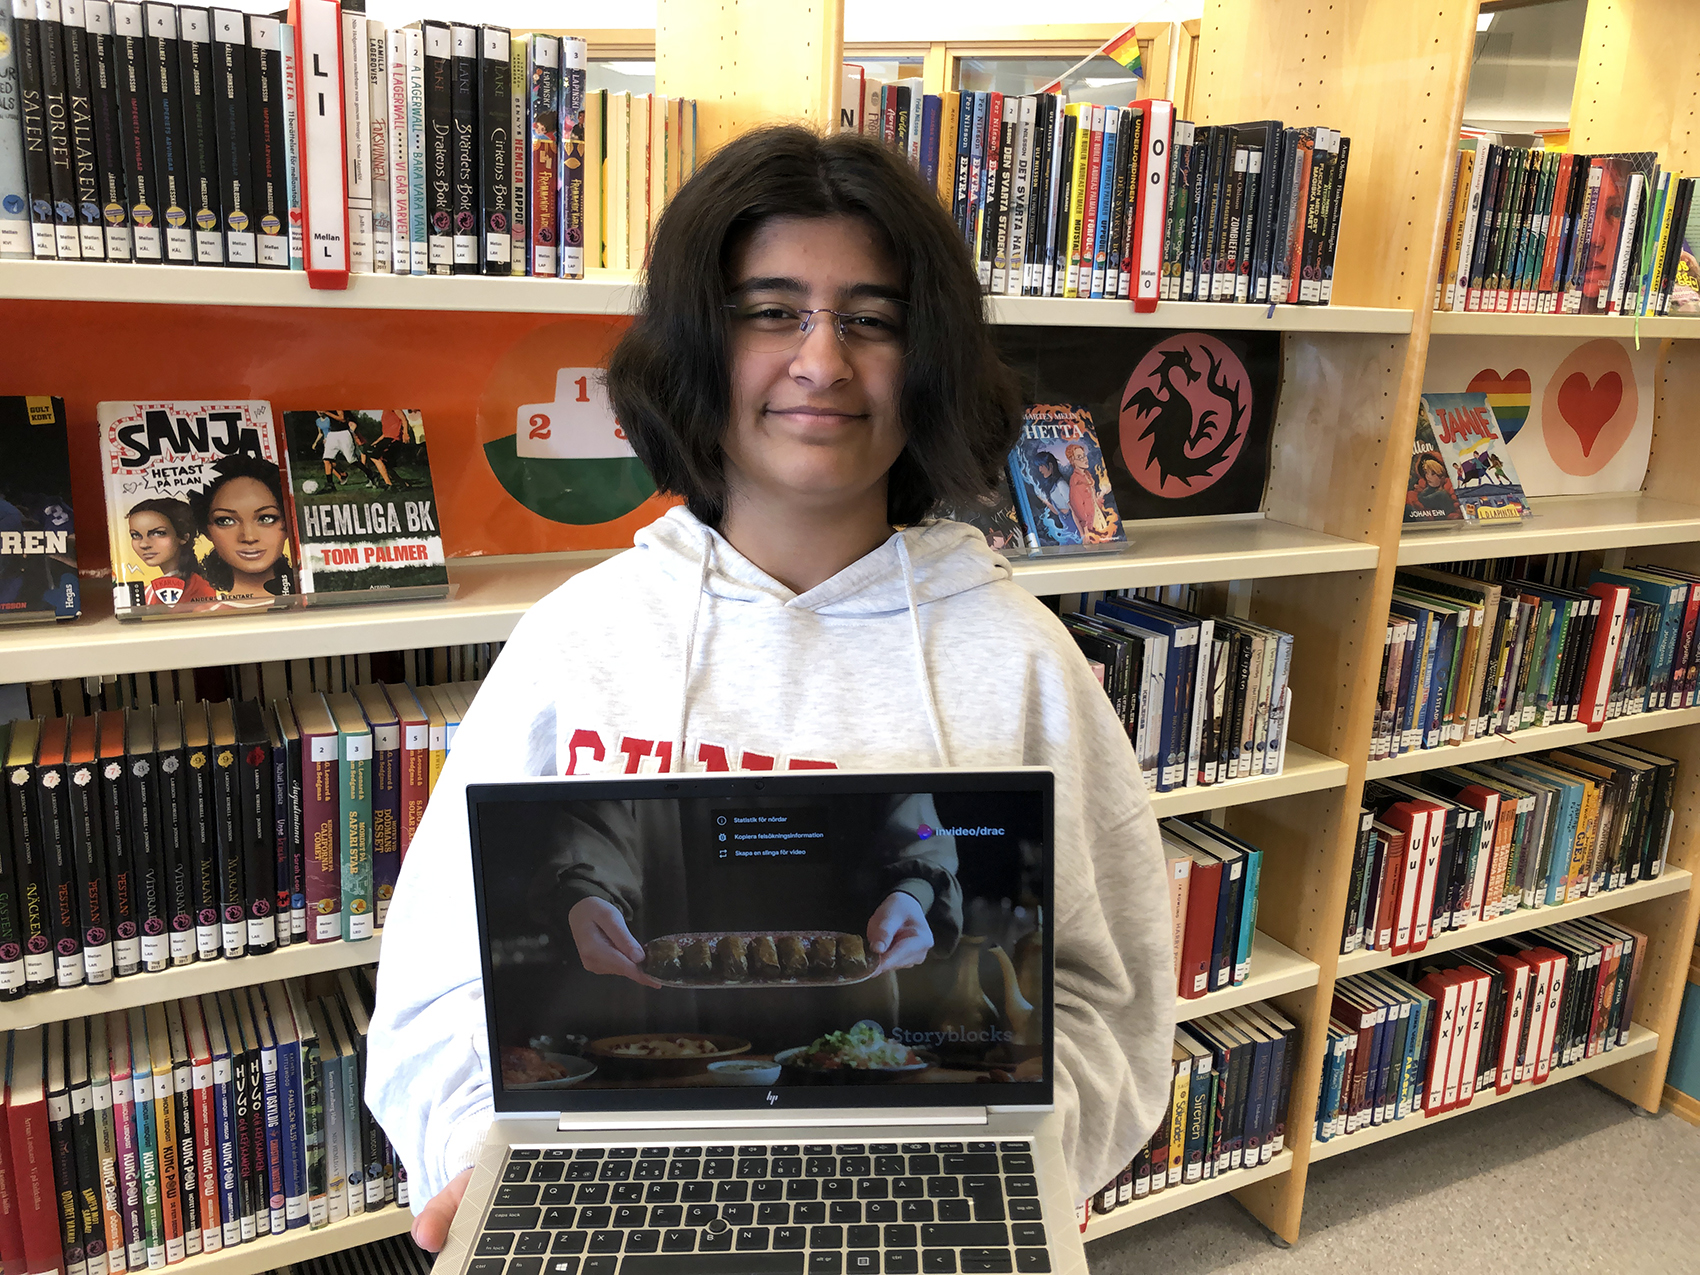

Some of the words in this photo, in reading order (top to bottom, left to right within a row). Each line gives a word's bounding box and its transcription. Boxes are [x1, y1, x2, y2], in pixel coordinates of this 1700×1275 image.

[286, 56, 294, 100] KÄRLEK
[313, 54, 328, 77] L
[393, 73, 404, 129] LAGERWALL
[411, 77, 423, 132] LAGERWALL
[572, 75, 580, 109] LAPINSKI
[23, 90, 43, 152] SALEN
[841, 109, 854, 127] N
[47, 93, 69, 169] TORPET
[288, 118, 296, 154] berättelser
[962, 115, 970, 148] Nilsson
[975, 116, 983, 149] Nilsson
[71, 96, 96, 202] KÄLLAREN
[432, 120, 449, 176] Drakens
[455, 119, 472, 180] Svärdets
[491, 128, 507, 180] Cirkelns
[1003, 147, 1012, 168] DEN
[1153, 139, 1164, 156] O
[396, 162, 404, 170] VI
[413, 152, 423, 178] BARA
[515, 139, 523, 183] HEMLIGA
[1018, 160, 1027, 181] DET
[1129, 119, 1141, 202] UNDERJORDINGEN
[396, 175, 408, 194] GÅR
[958, 156, 968, 200] EXTRA
[970, 158, 981, 202] EXTRA
[1090, 165, 1098, 190] ANDREAS
[1310, 167, 1319, 201] MAGISKA
[1316, 163, 1324, 196] FLICKAN
[414, 184, 423, 210] VARA
[435, 180, 446, 207] Bok
[459, 183, 471, 210] Bok
[493, 184, 506, 210] Bok
[1000, 172, 1009, 211] SVARTA
[396, 199, 408, 235] VARVET
[1014, 186, 1025, 230] SVARTA
[314, 233, 341, 242] Mellan
[997, 216, 1007, 256] STADEN
[1455, 220, 1464, 251] TRETTON
[324, 247, 332, 258] L
[574, 376, 590, 402] 1
[32, 413, 52, 421] KORT
[529, 413, 551, 440] 2
[1435, 405, 1499, 444] JAMIE
[118, 410, 264, 467] SANJA
[1024, 424, 1084, 439] HETTA
[152, 464, 204, 479] HETAST
[157, 477, 172, 488] PÅ
[174, 476, 201, 486] PLAN
[44, 504, 69, 526] 3
[303, 502, 401, 537] HEMLIGA
[404, 501, 435, 532] BK
[1409, 510, 1432, 518] JOHAN
[1432, 509, 1446, 517] EHN
[0, 531, 68, 554] REN
[321, 548, 359, 566] TOM
[364, 544, 428, 563] PALMER
[65, 583, 75, 608] Hegas
[281, 574, 291, 597] Hegas
[1615, 615, 1621, 626] T
[1611, 635, 1616, 645] t
[349, 811, 358, 848] SAFARI
[374, 810, 383, 853] PASSET
[384, 809, 392, 852] DÖDMANS
[734, 833, 757, 841] Kopiera
[757, 832, 824, 841] felsökningsinformation
[935, 826, 1005, 837] invideo/drac
[1484, 820, 1494, 831] W
[735, 850, 753, 858] Skapa
[762, 849, 779, 857] slinga
[1412, 838, 1421, 850] U
[1431, 836, 1439, 847] V
[1410, 860, 1417, 870] u
[58, 881, 71, 927] PESTAN
[117, 871, 129, 916] PESTAN
[1515, 988, 1522, 1001] Å
[1537, 983, 1545, 996] Ä
[1553, 979, 1561, 992] Ö
[1444, 1009, 1452, 1021] X
[1461, 1005, 1468, 1016] Y
[1475, 1001, 1483, 1012] Z
[1535, 1002, 1541, 1013] ä
[891, 1024, 1013, 1046] Storyblocks
[1442, 1030, 1448, 1038] x
[1457, 1025, 1464, 1036] y
[1473, 1021, 1479, 1030] z
[250, 1059, 261, 1110] HUGO
[265, 1072, 277, 1093] TOTALT
[1401, 1057, 1413, 1104] ALASKA
[766, 1091, 778, 1105] hp
[267, 1096, 279, 1128] OSKYLDIG
[1192, 1094, 1205, 1140] Sirenen
[182, 1138, 194, 1165] KUNG
[102, 1157, 114, 1185] KUNG
[183, 1166, 195, 1191] POW
[105, 1186, 118, 1211] POW
[549, 1187, 558, 1195] Q
